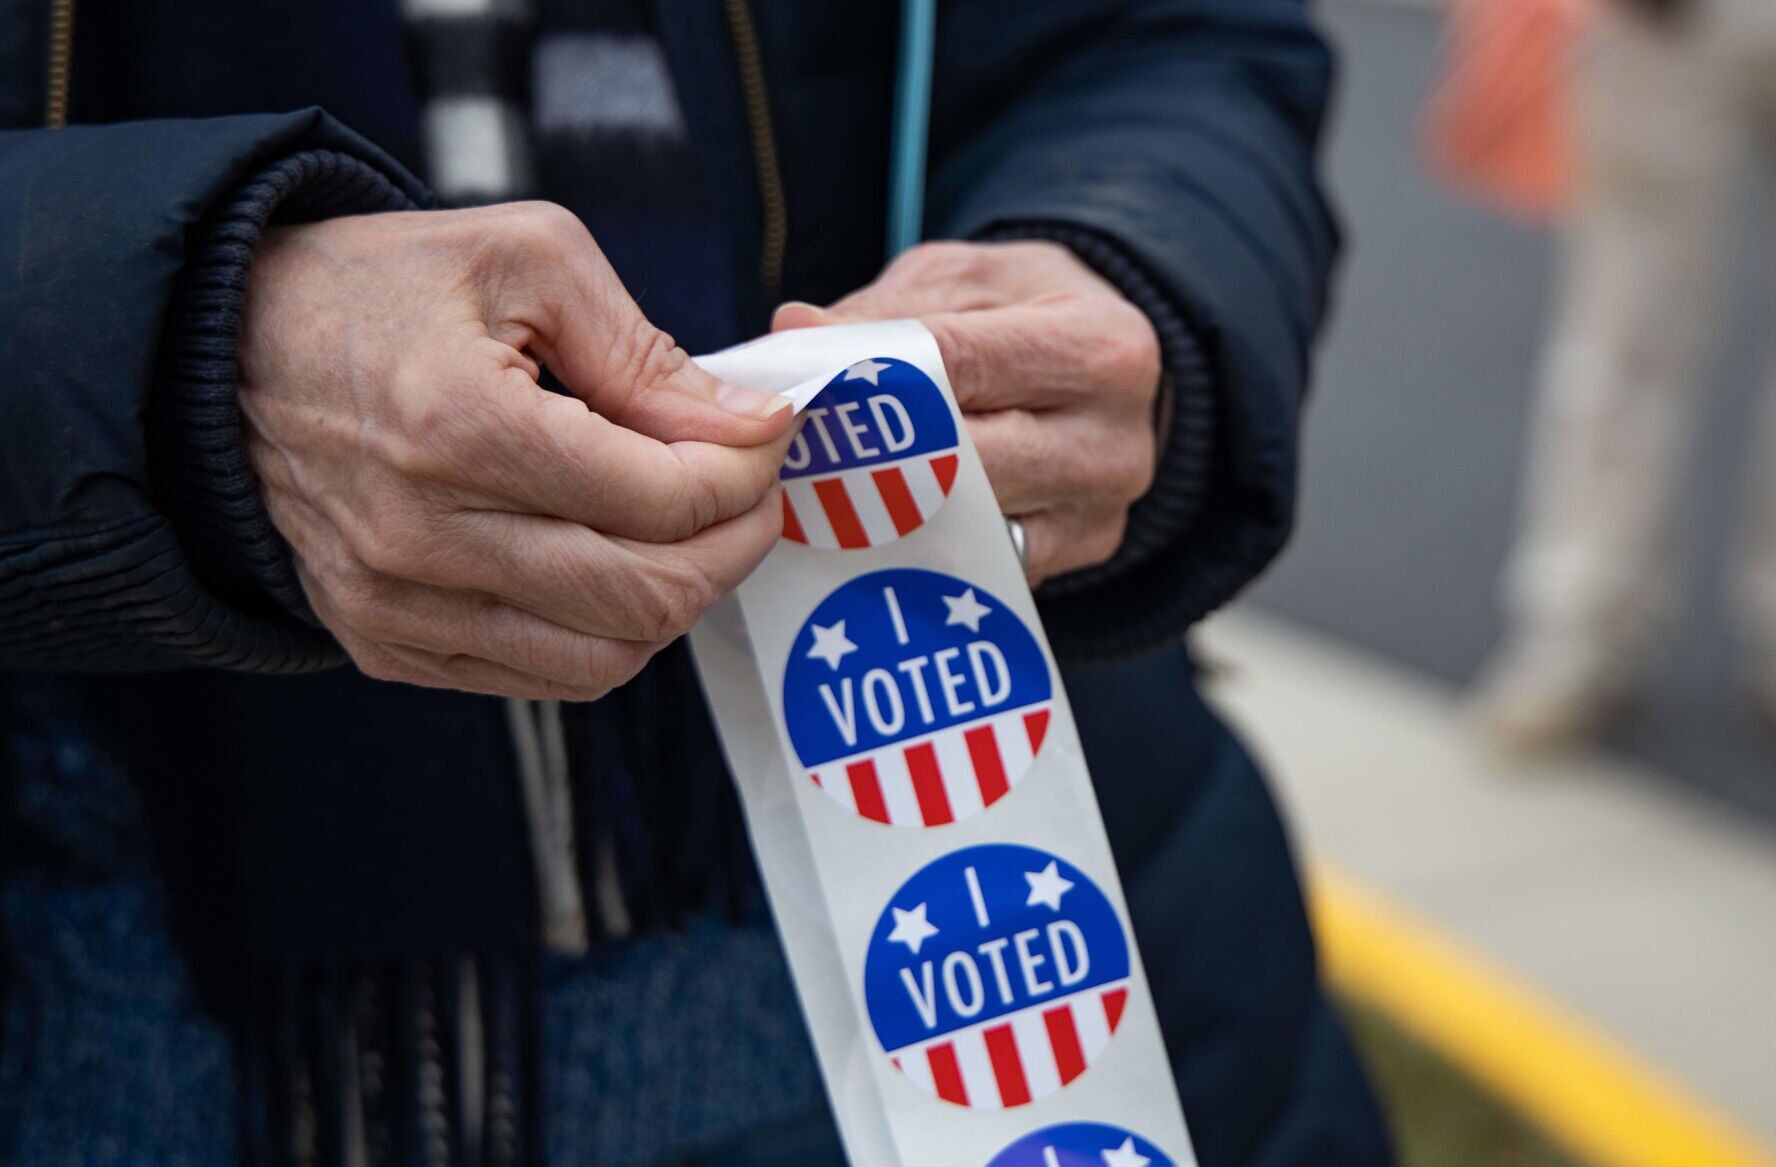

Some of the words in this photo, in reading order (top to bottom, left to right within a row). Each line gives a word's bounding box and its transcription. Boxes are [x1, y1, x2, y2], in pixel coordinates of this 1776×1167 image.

[785, 394, 915, 470] OTED
[884, 586, 909, 645] I
[818, 640, 1012, 747] VOTED
[964, 866, 990, 928] I
[900, 919, 1091, 1030] VOTED
